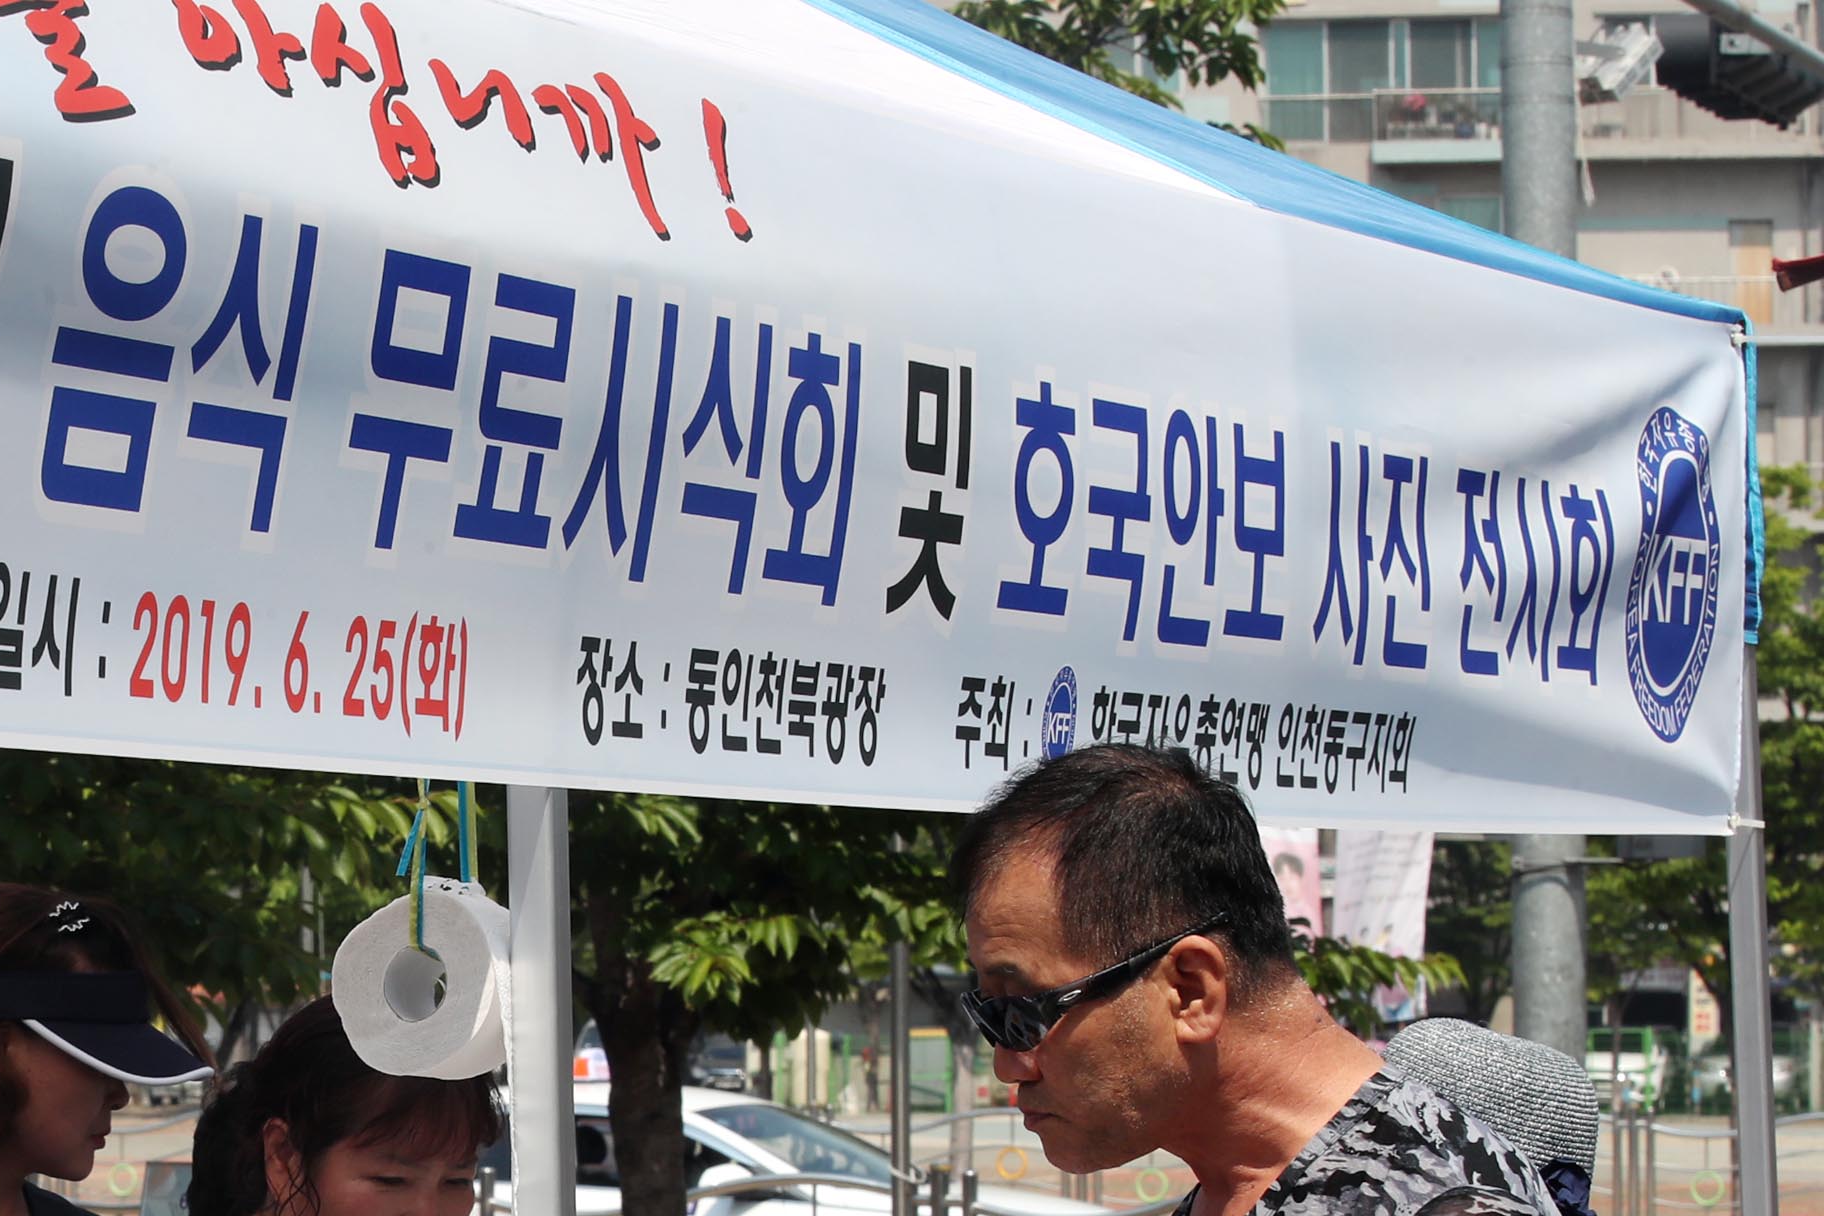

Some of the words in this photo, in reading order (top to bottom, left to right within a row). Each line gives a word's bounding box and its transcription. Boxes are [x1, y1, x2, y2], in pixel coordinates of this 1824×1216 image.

[40, 185, 319, 534] 음식
[347, 249, 862, 607] 무료시식회
[885, 360, 972, 622] 및
[996, 381, 1286, 647] 호국안보
[1312, 441, 1429, 671] 사진
[1455, 469, 1614, 687] 전시회
[1626, 531, 1650, 657] KOREA
[1642, 532, 1708, 626] KFF
[1674, 542, 1720, 730] FEDERATION
[128, 590, 262, 709] 2019.
[283, 610, 321, 714] 6.
[342, 610, 468, 742] 25(화)
[576, 636, 644, 746] 장소
[684, 648, 886, 767] 동인천북광장
[1630, 656, 1678, 737] FREEDOM
[955, 675, 1016, 771] 주최
[1276, 702, 1417, 795] 인천동구지회
